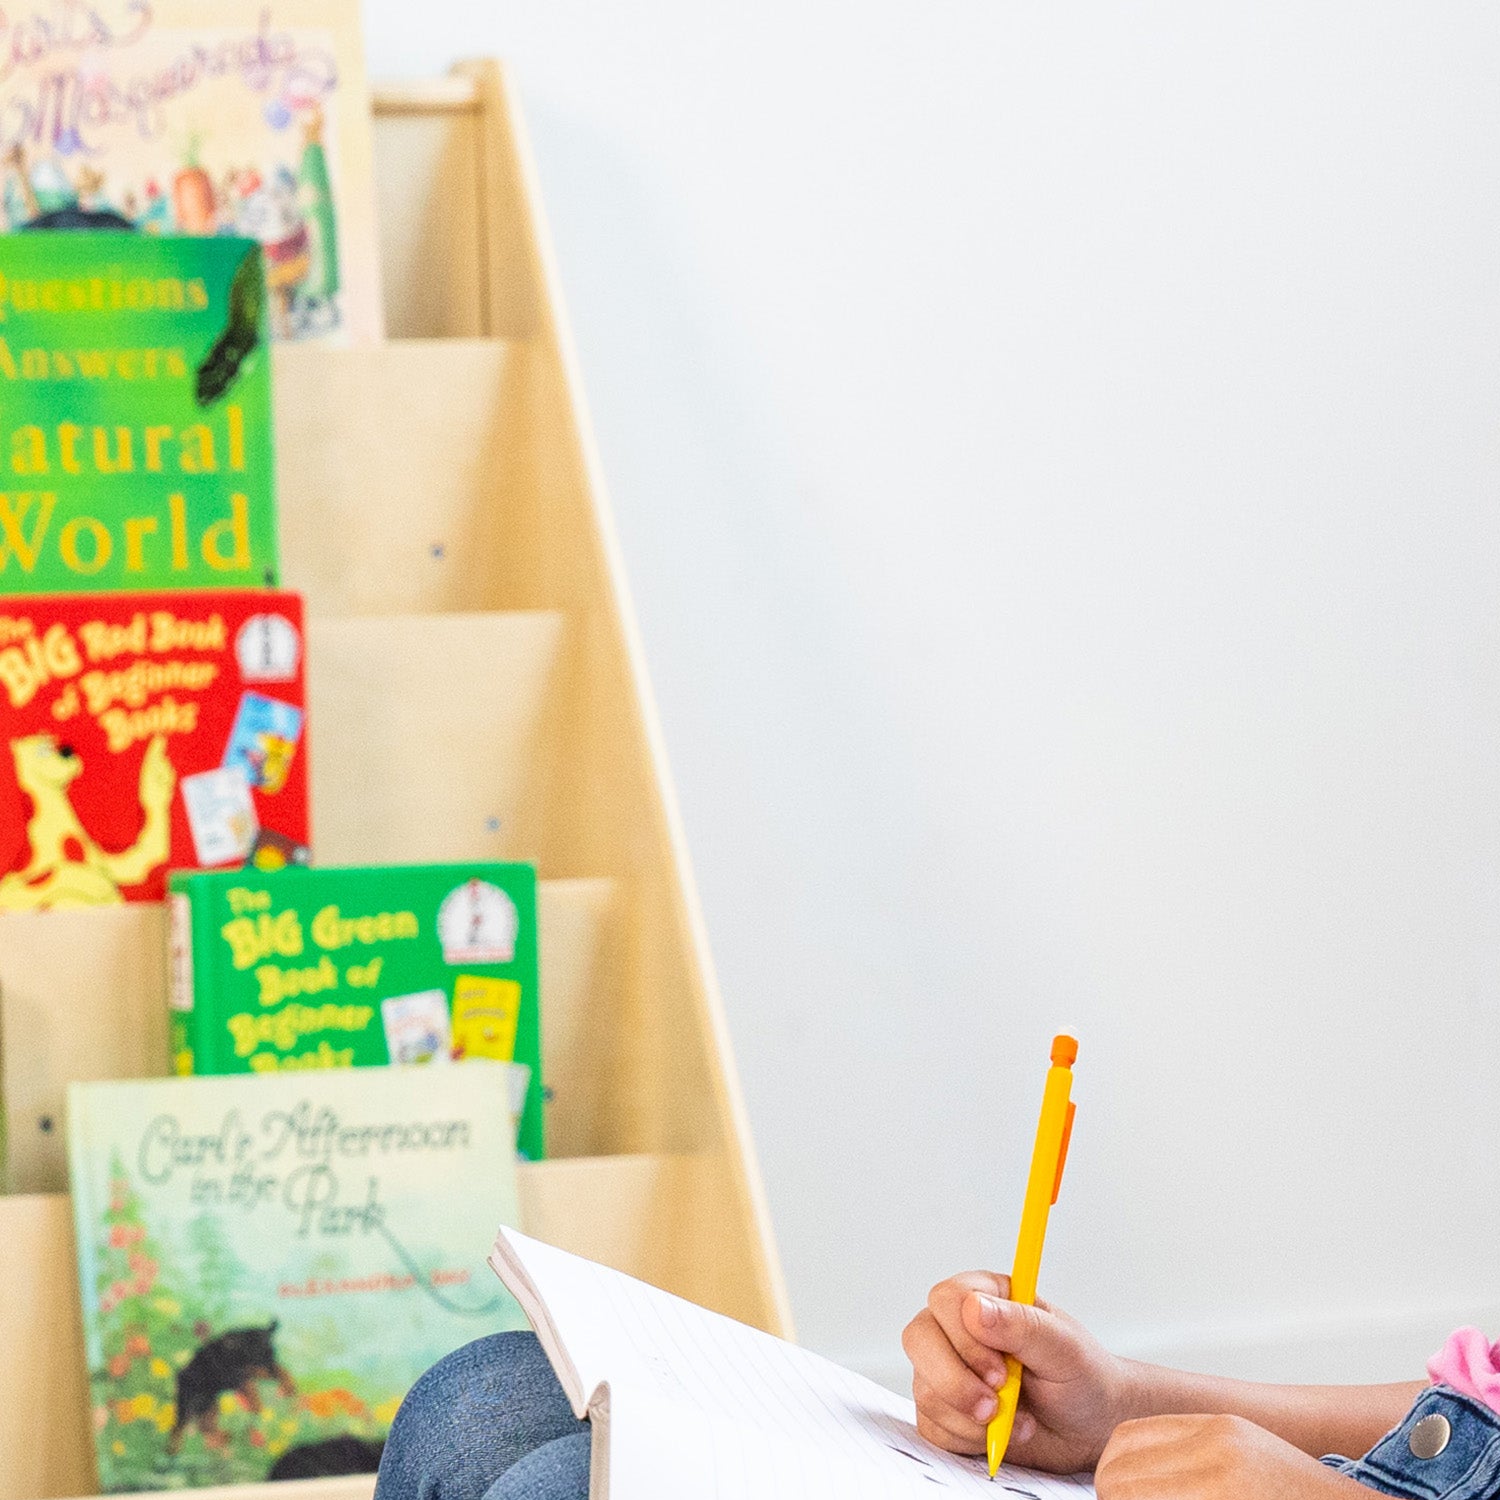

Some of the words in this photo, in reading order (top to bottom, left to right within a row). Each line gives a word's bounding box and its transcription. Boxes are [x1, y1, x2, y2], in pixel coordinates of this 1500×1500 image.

[0, 265, 208, 322] uestions
[0, 404, 247, 475] atural
[0, 622, 82, 709] BIG
[78, 611, 147, 663] Red
[221, 908, 304, 971] BIG
[310, 904, 420, 951] Green
[254, 955, 340, 1007] Book
[346, 956, 385, 989] of
